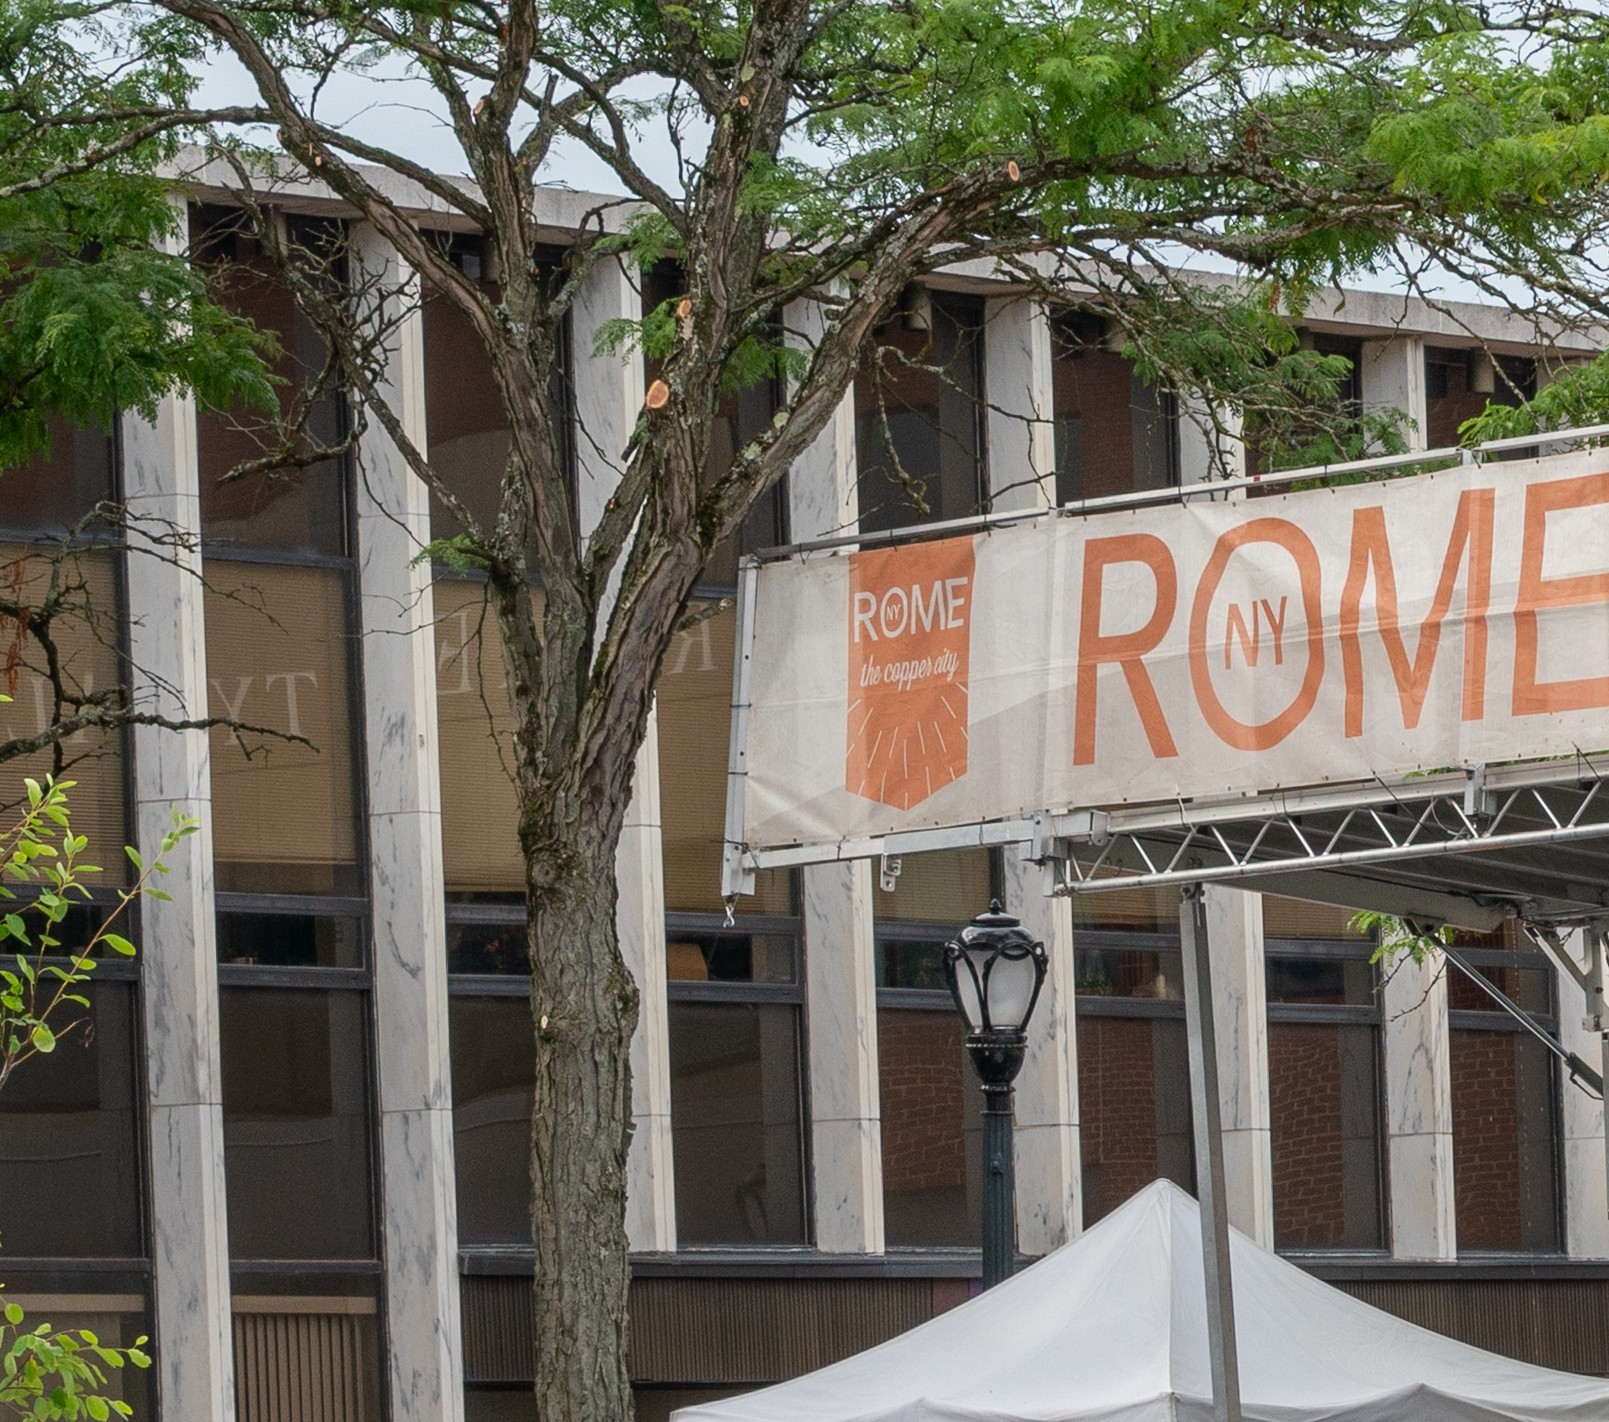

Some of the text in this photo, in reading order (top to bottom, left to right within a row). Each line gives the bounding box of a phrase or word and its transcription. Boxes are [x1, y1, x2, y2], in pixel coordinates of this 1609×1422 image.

[853, 576, 969, 643] ROME
[886, 603, 902, 622] NY
[1224, 595, 1288, 670] NY
[860, 647, 960, 692] the copper city
